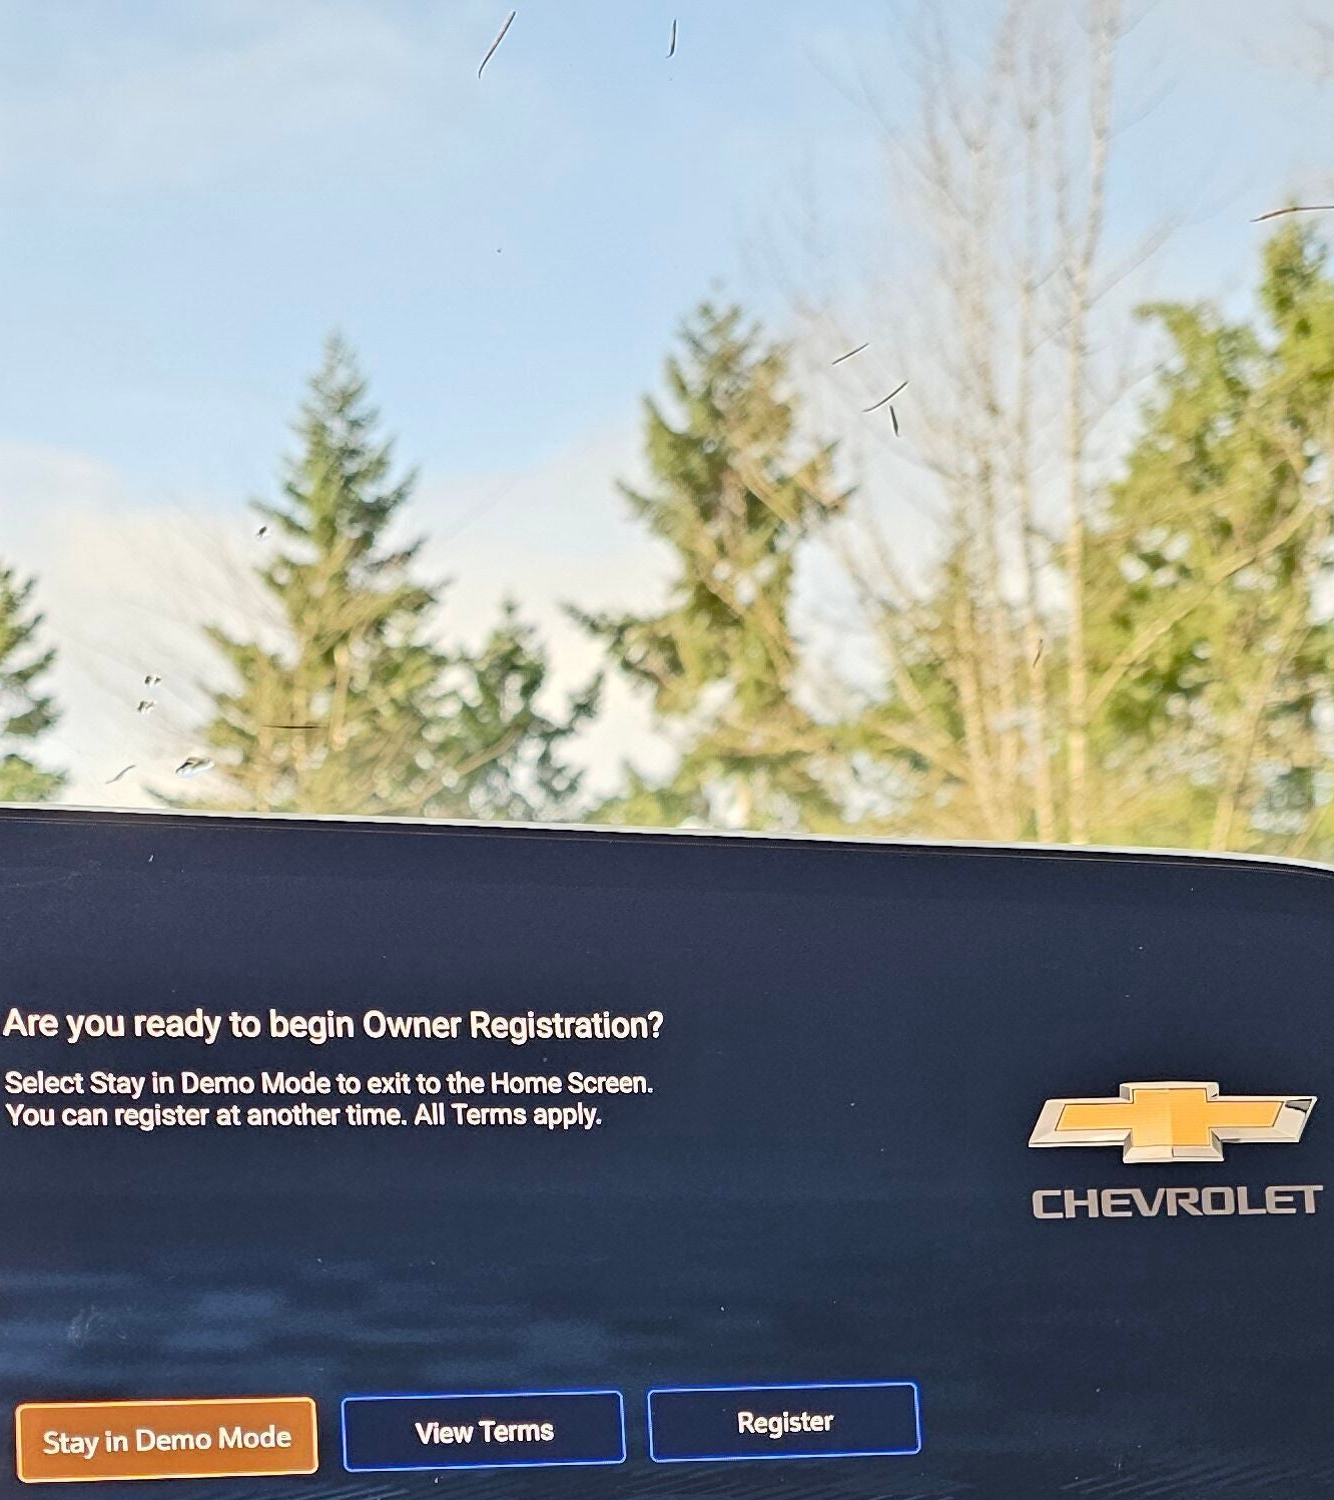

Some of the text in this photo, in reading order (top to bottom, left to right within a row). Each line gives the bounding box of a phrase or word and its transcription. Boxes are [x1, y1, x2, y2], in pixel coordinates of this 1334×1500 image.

[3, 1008, 664, 1045] Are you ready to begin Owner Registration?
[5, 1070, 654, 1100] Select Stay in Demo Mode to exit to the Home Screen.
[5, 1102, 603, 1131] You can register at another time. All Terms apply.
[1031, 1185, 1324, 1220] CHEVROLET
[414, 1420, 555, 1444] View Terms
[737, 1410, 835, 1440] Register
[43, 1425, 292, 1460] Stay in Demo Mode
